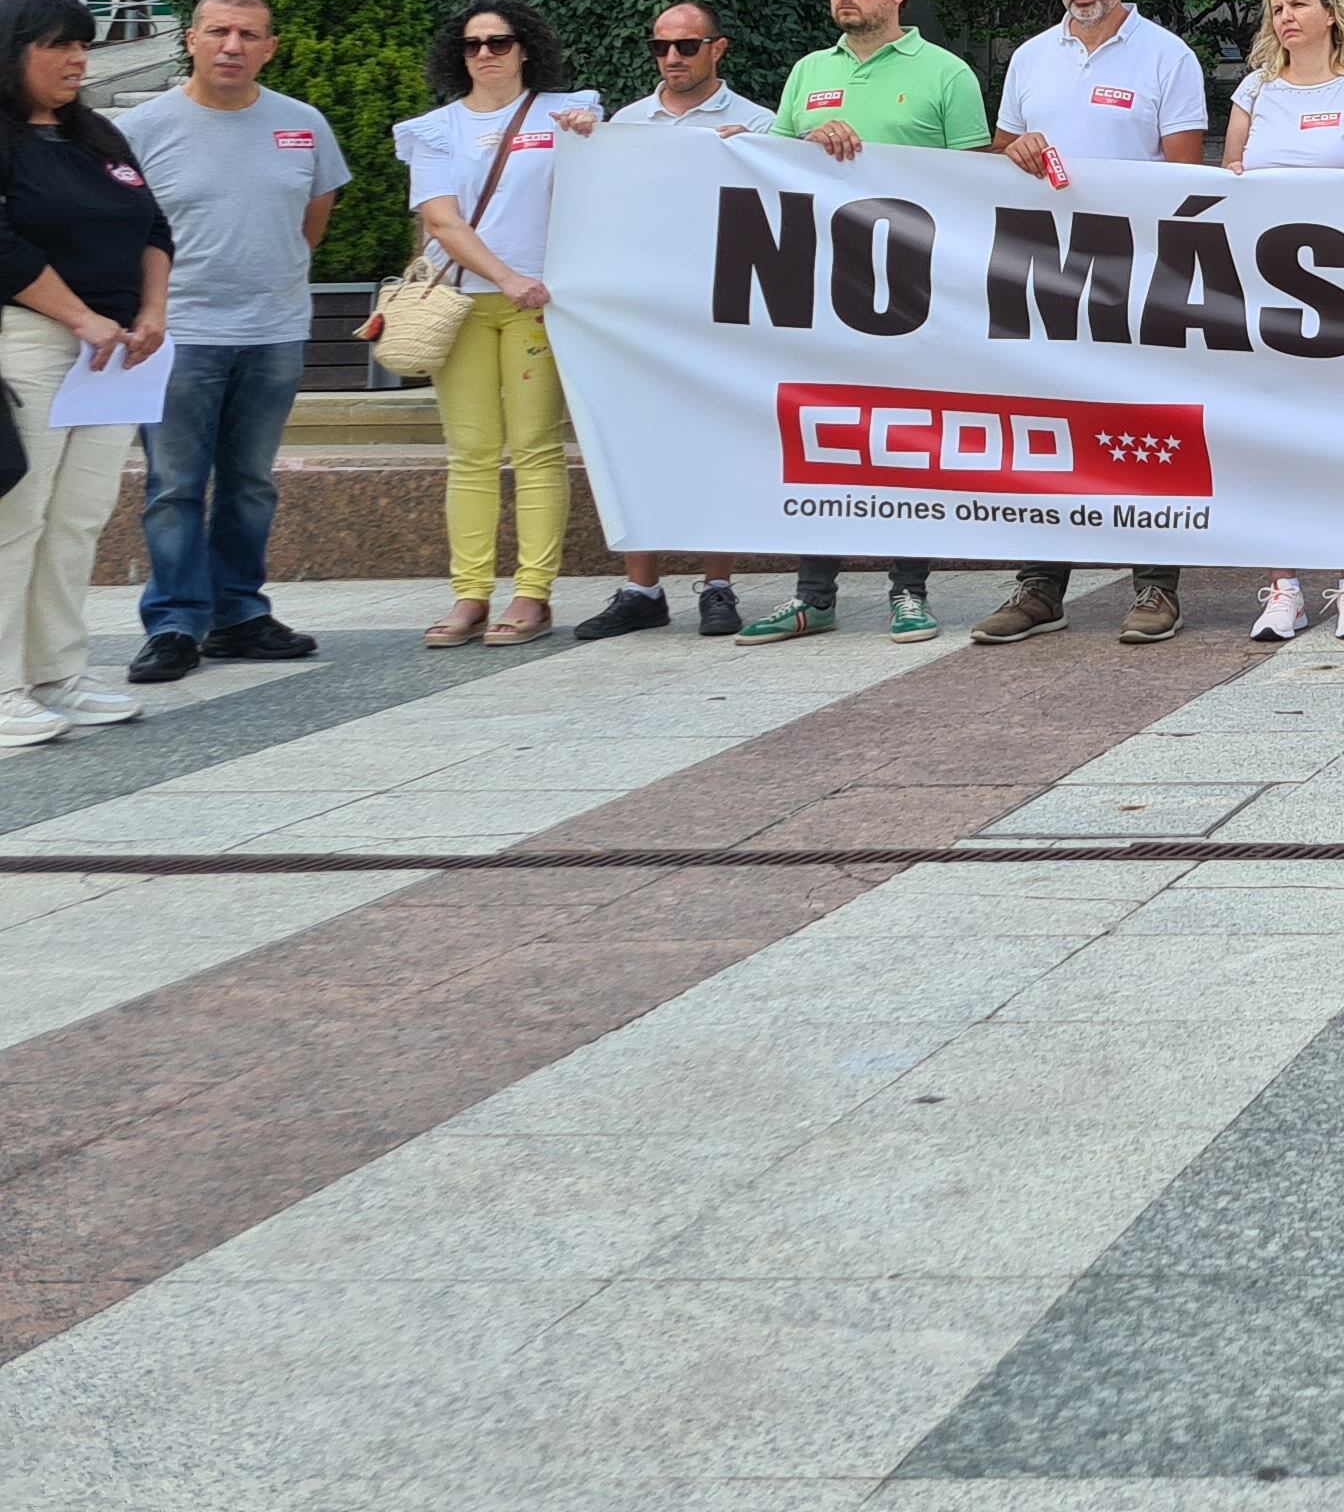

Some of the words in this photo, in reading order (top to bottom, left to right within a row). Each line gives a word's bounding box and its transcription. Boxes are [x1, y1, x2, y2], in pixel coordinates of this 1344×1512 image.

[712, 186, 936, 337] NO
[798, 404, 1075, 473] CCOO
[783, 494, 946, 521] comisiones
[955, 500, 1061, 525] obreras
[1069, 504, 1104, 527] de
[1112, 505, 1211, 530] Madrid
